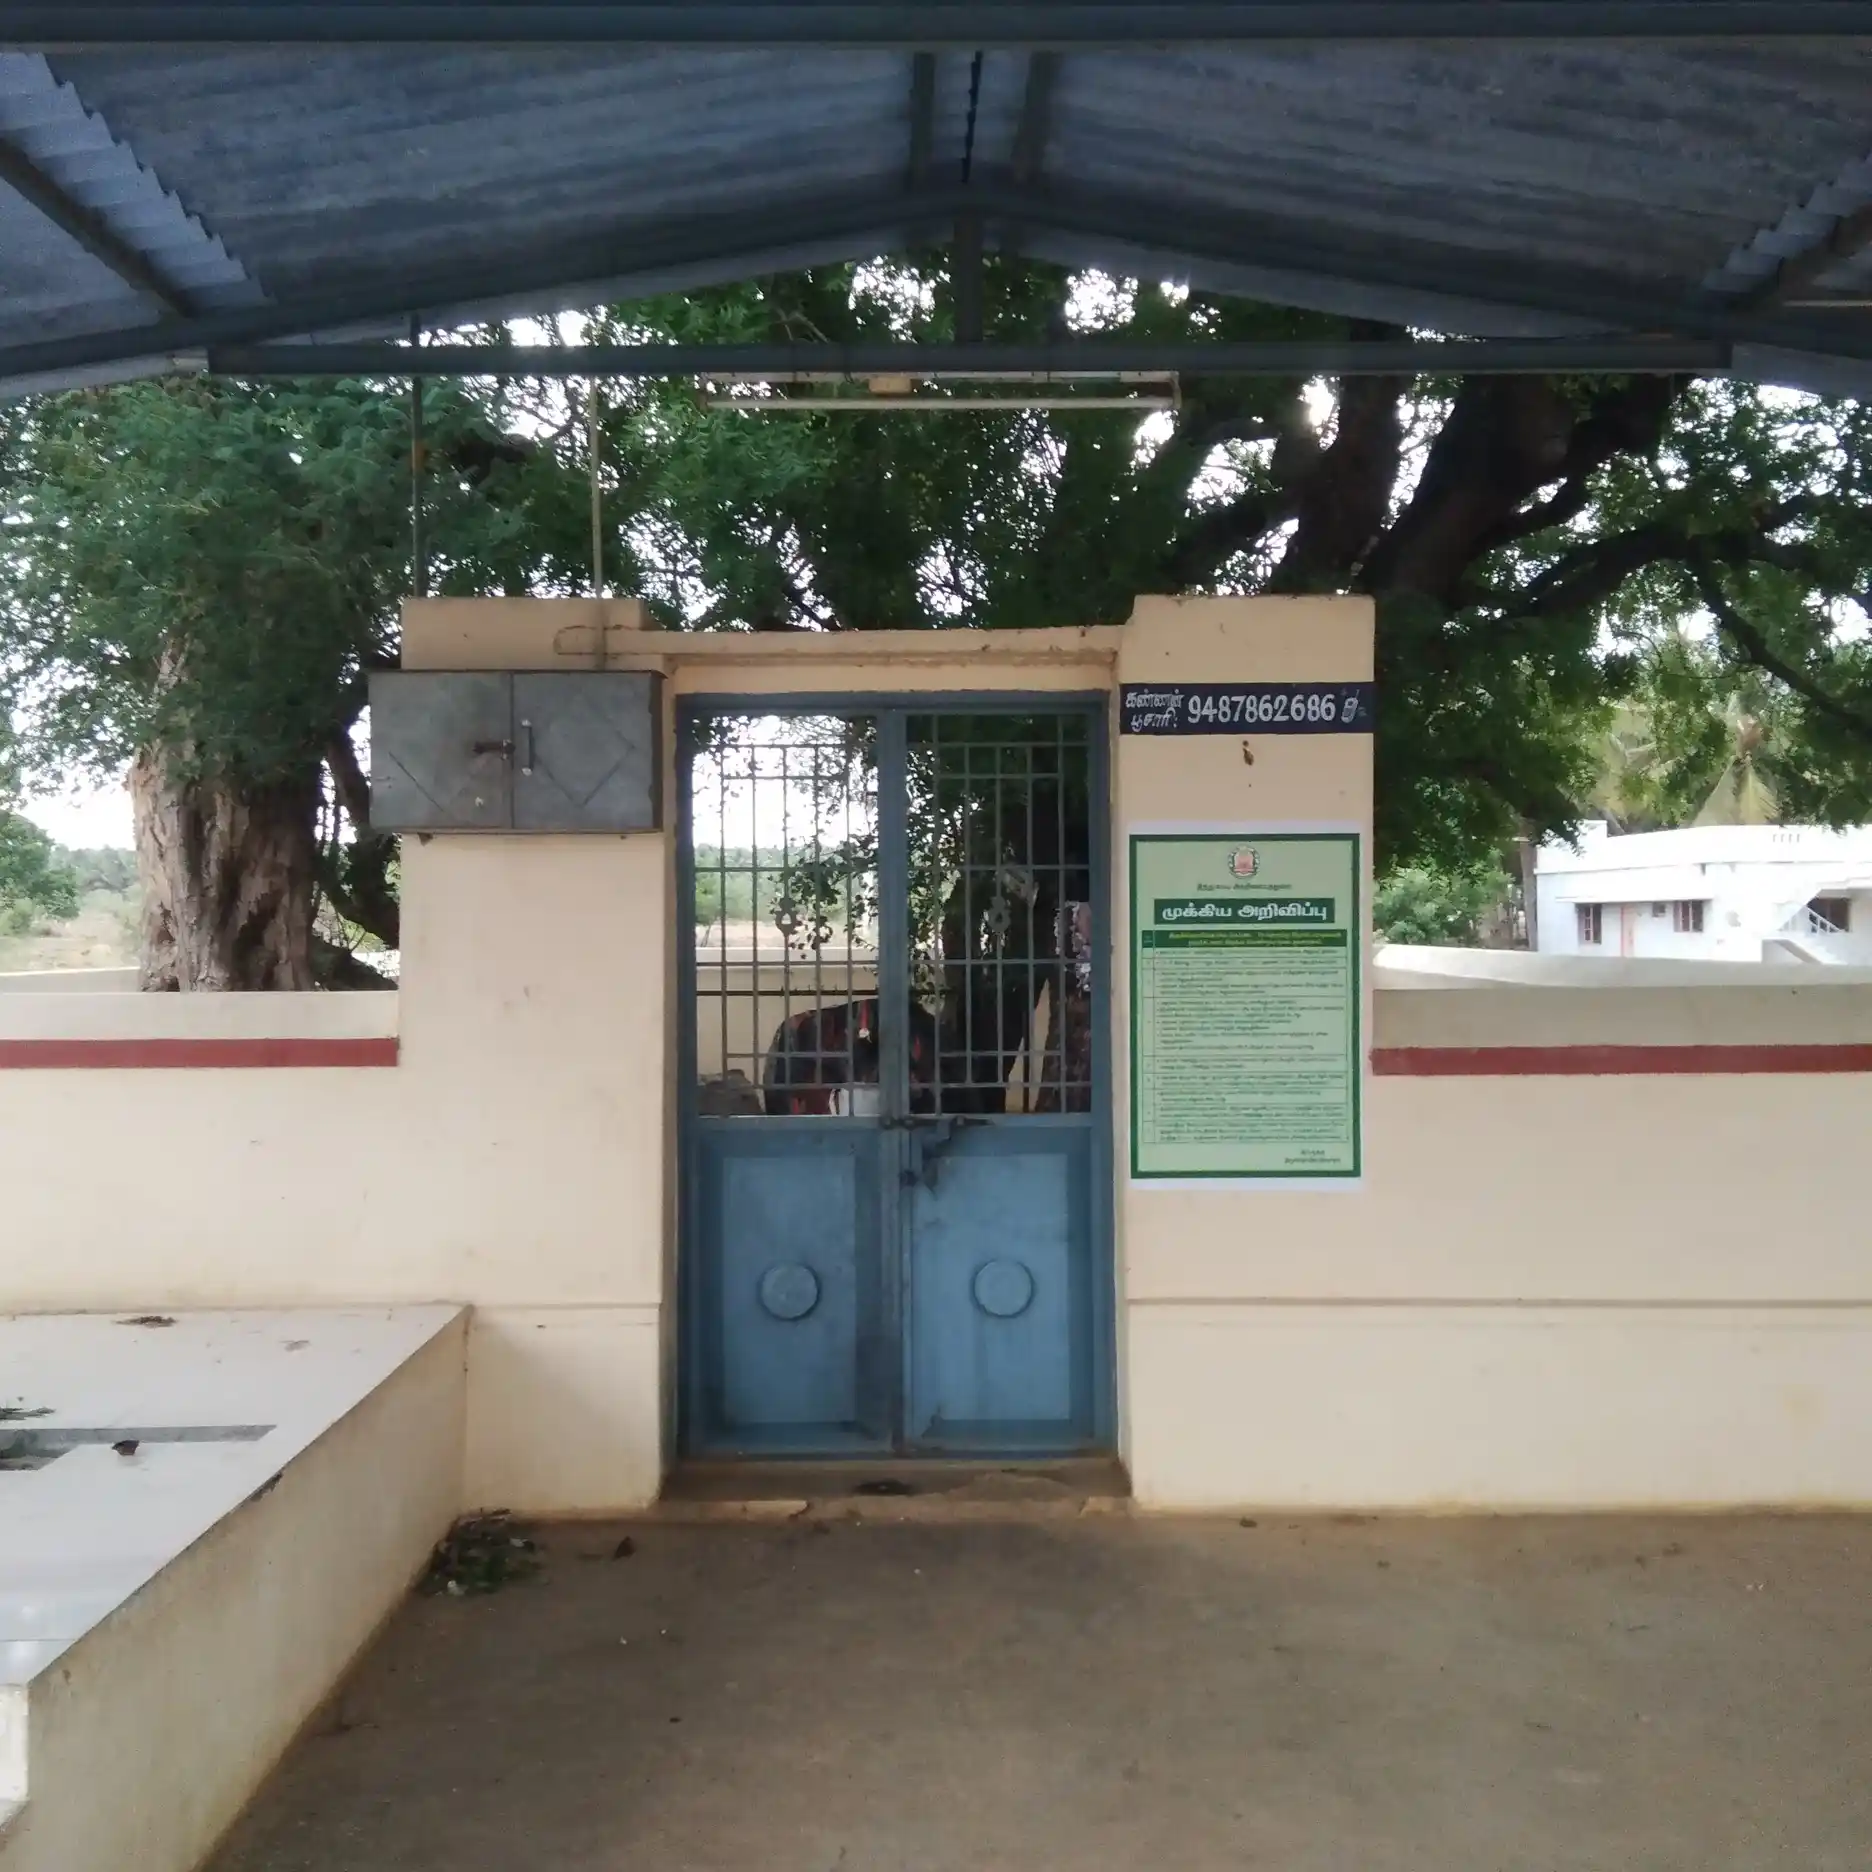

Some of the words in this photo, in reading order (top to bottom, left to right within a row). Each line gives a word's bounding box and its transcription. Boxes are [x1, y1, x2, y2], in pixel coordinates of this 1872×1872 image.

[1187, 694, 1336, 723] 9487862686
[1162, 902, 1232, 920] முக்கிய
[1237, 902, 1327, 921] அறிவிப்பு
